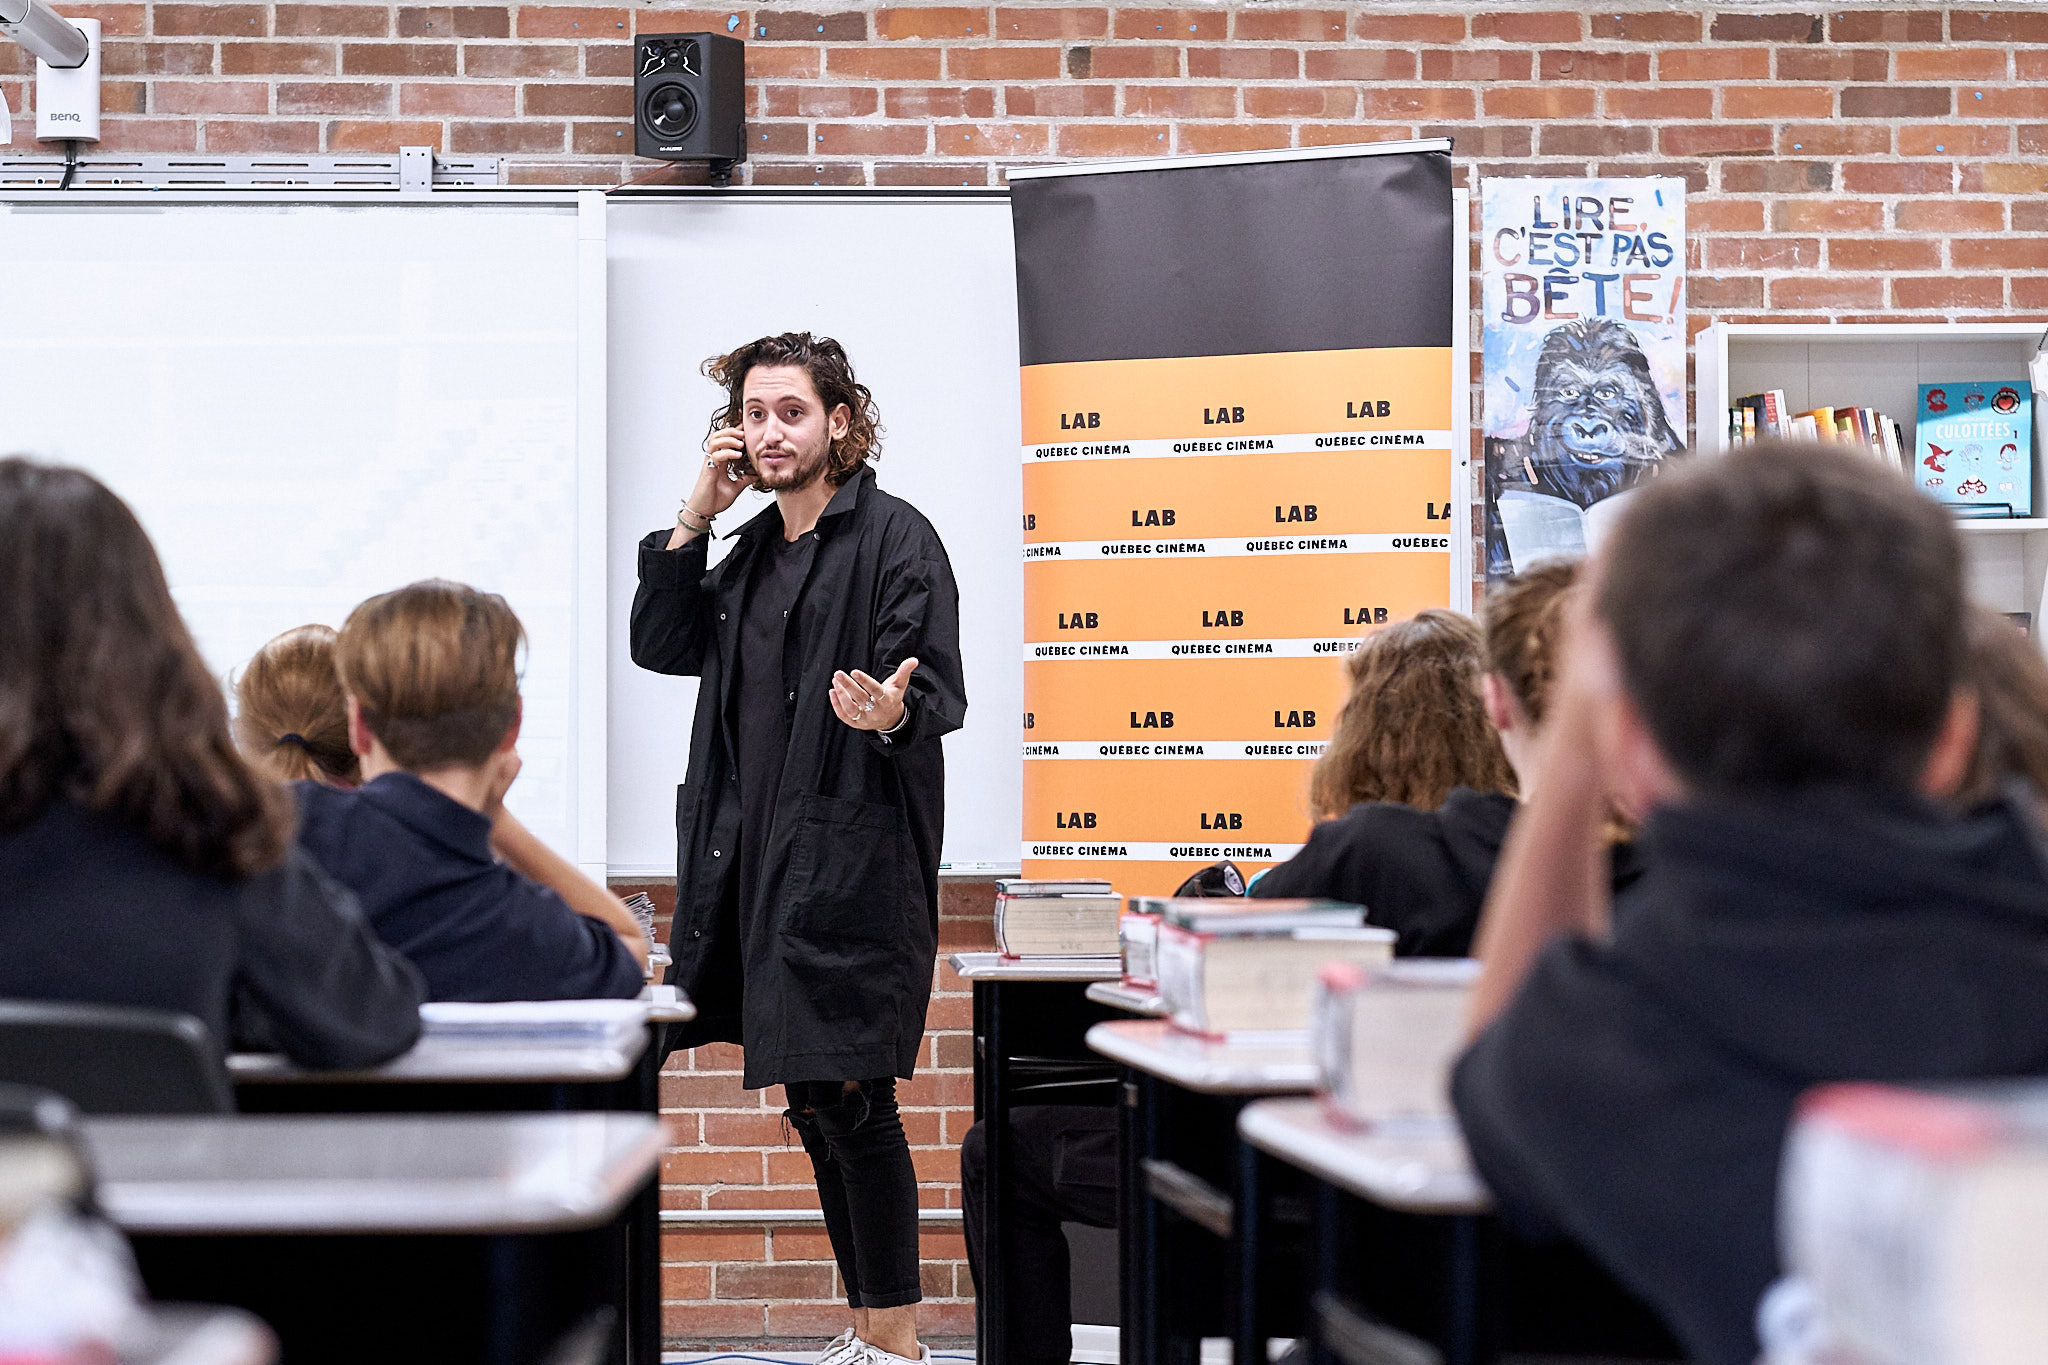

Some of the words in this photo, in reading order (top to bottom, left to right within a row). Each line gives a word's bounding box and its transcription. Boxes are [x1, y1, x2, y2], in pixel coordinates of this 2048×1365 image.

[1495, 227, 1603, 266] C'EST
[1611, 232, 1674, 268] PAS
[1502, 268, 1683, 324] BÊTE!
[1204, 407, 1245, 424] LAB
[1347, 401, 1391, 418] LAB
[1061, 413, 1101, 429] LAB
[1936, 421, 2011, 439] CULOTTÉES
[2013, 430, 2018, 439] 1
[1174, 442, 1221, 453] QUÉBEC
[1227, 440, 1273, 450] CINÉMA
[1315, 437, 1365, 447] QUÉBEC
[1371, 435, 1424, 444] CINÉMA
[1036, 447, 1077, 458] QUÉBEC
[1082, 445, 1130, 455] CINÉMA
[1132, 510, 1176, 526] LAB
[1276, 505, 1318, 522] LAB
[1427, 503, 1451, 519] LA
[1102, 545, 1151, 555] QUÉBEC
[1156, 543, 1205, 553] CINÉMA
[1247, 541, 1293, 552] QUÉBEC
[1299, 539, 1347, 549] CINÉMA
[1392, 538, 1448, 548] QUÉBEC
[1027, 547, 1061, 557] CINÉMA
[1059, 613, 1098, 629] LAB
[1203, 611, 1243, 628] LAB
[1344, 608, 1388, 624] LAB
[1036, 646, 1075, 657] QUÉBEC
[1080, 645, 1128, 655] CINÉMA
[1172, 644, 1220, 655] QUÉBEC
[1225, 644, 1272, 653] CINÉMA
[1131, 712, 1174, 728] LAB
[1275, 711, 1316, 727] LAB
[1026, 746, 1059, 755] CINÉMA
[1100, 745, 1149, 755] QUÉBEC
[1155, 745, 1203, 754] CINÉMA
[1245, 745, 1293, 755] QUÉBEC
[1057, 813, 1097, 829] LAB
[1201, 813, 1242, 830] LAB
[1033, 846, 1073, 855] QUÉBEC
[1078, 846, 1127, 855] CINÉMA
[1170, 847, 1219, 857] QUÉBEC
[1224, 847, 1272, 857] CINÉMA
